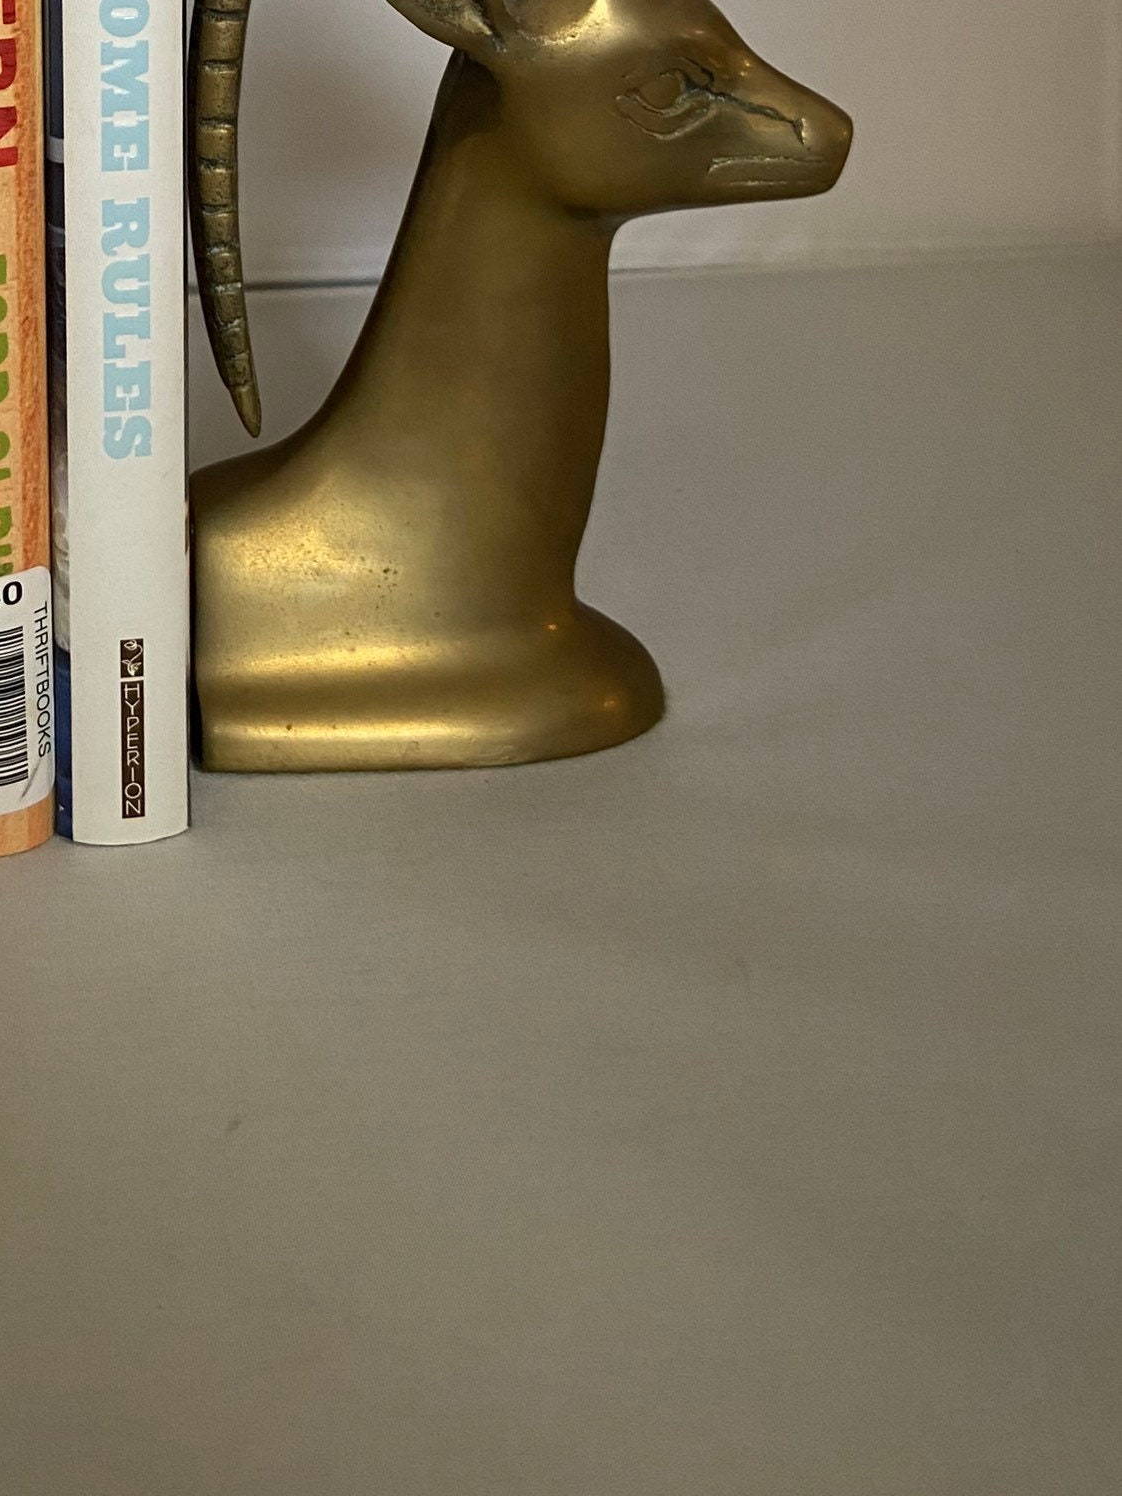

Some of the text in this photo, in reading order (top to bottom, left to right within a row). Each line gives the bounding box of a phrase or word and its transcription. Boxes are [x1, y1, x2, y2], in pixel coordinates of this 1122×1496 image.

[101, 196, 152, 460] RULES
[33, 601, 52, 758] THRIFTBOOKS
[124, 683, 142, 815] HYPERION
